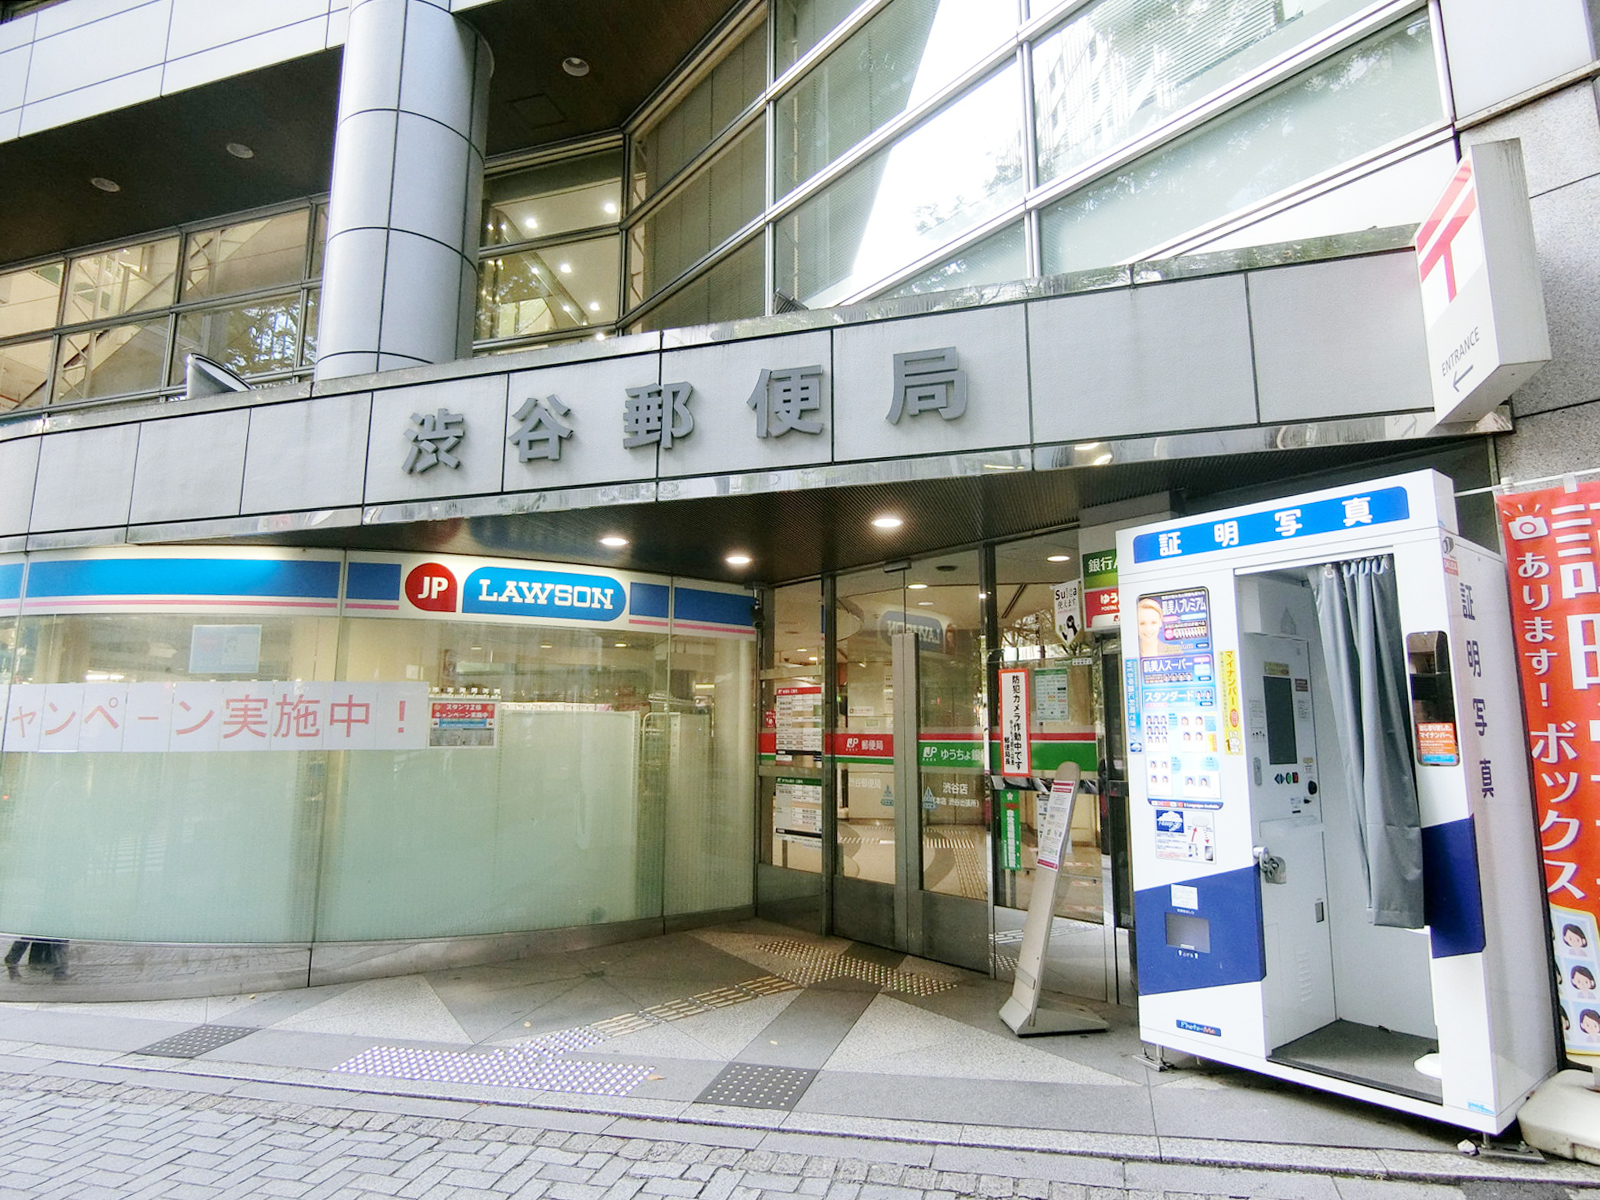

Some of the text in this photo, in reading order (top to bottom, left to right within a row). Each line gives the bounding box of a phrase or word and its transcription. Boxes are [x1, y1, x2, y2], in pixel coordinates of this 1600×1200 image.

[1441, 326, 1480, 377] ENTRANCE
[402, 346, 968, 475] 渋谷郵便局
[1158, 496, 1373, 557] 証明写真
[417, 576, 615, 610] JP LAWSON
[1055, 588, 1077, 600] Suica
[1145, 690, 1195, 702] スタンダード
[1459, 582, 1494, 799] 証明写真
[0, 693, 407, 739] ャンペーン実施中！
[1012, 675, 1022, 770] 防犯カメラ作動中です
[861, 740, 884, 751] 郵便局
[943, 782, 968, 794] 渋谷店
